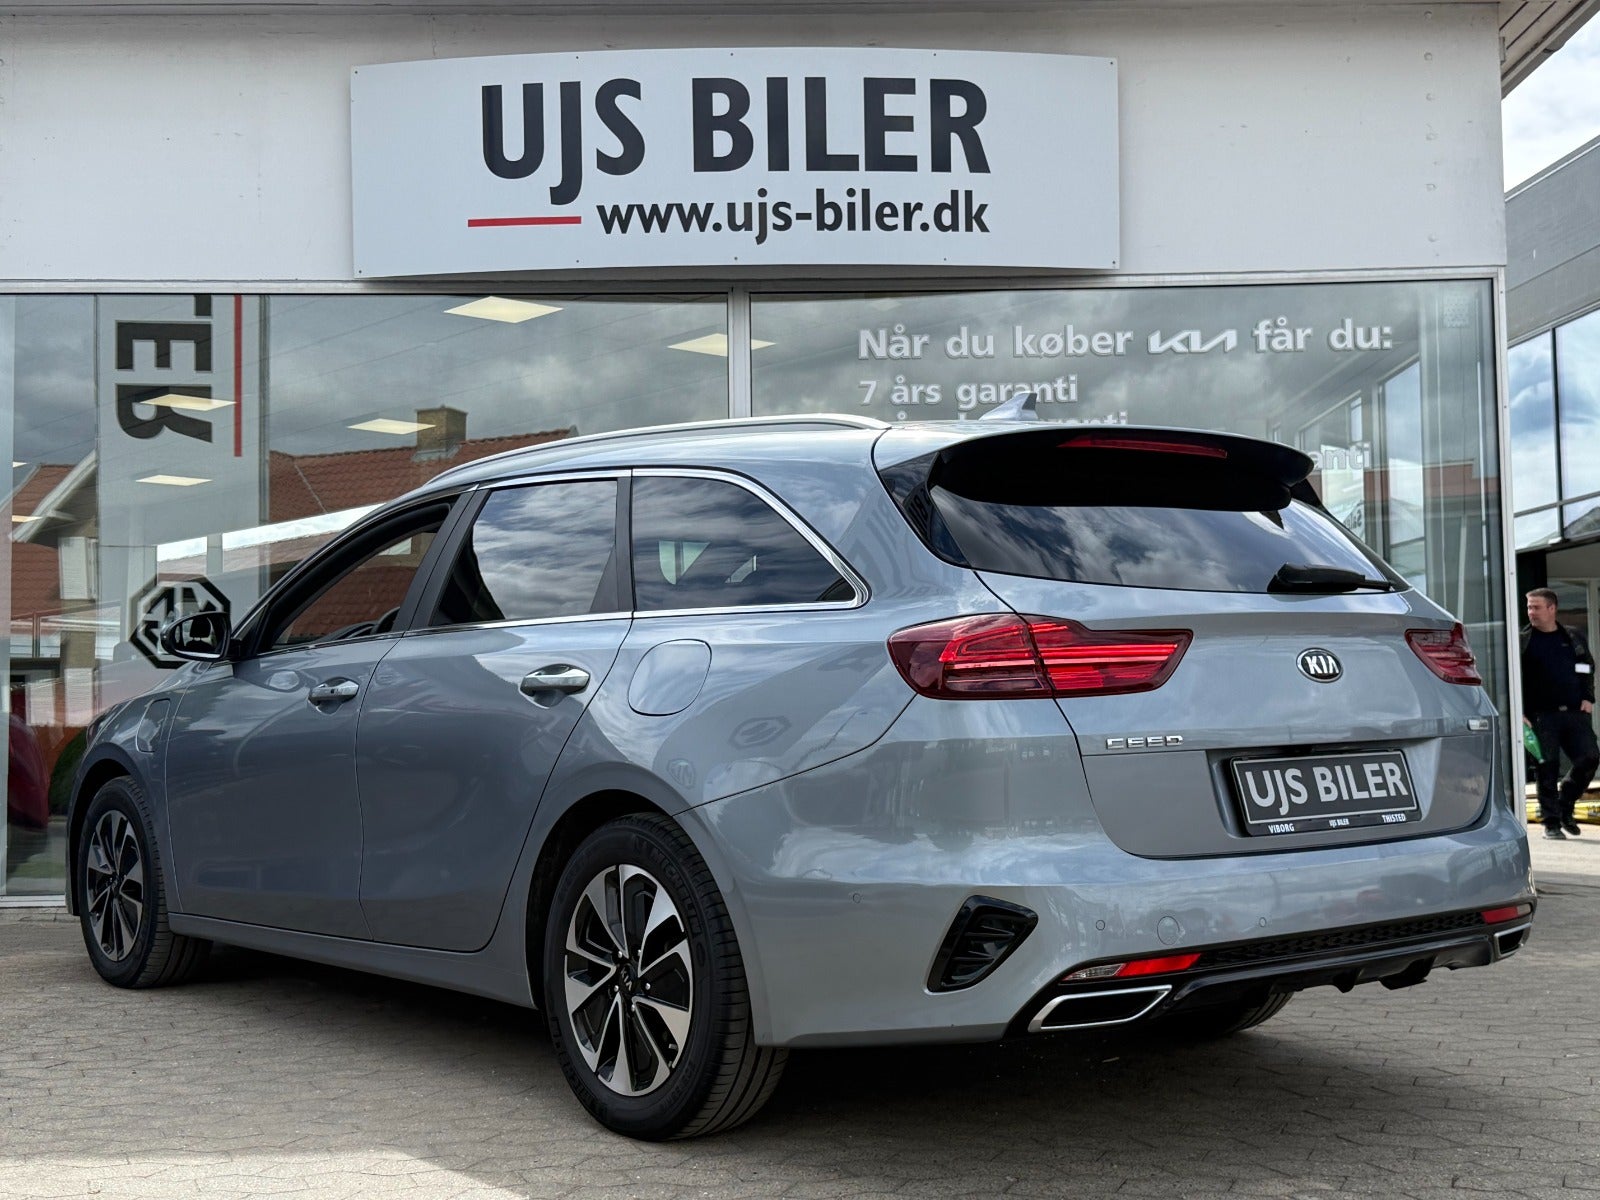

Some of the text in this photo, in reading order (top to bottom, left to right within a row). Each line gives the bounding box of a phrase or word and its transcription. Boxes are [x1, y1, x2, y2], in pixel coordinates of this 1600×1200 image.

[482, 76, 991, 205] UJS BILER
[596, 187, 991, 245] www.ujs-biler.dk
[858, 324, 929, 360] Når
[945, 327, 994, 358] du
[1014, 324, 1132, 358] køber
[1253, 317, 1312, 353] får
[1328, 318, 1393, 351] du:
[859, 380, 877, 403] 7
[891, 375, 942, 404] års
[1304, 655, 1340, 674] KIA
[1106, 735, 1184, 749] CEED
[1245, 761, 1408, 815] UJS BILER
[1268, 822, 1295, 834] VIBORG
[1381, 813, 1406, 823] THISTED
